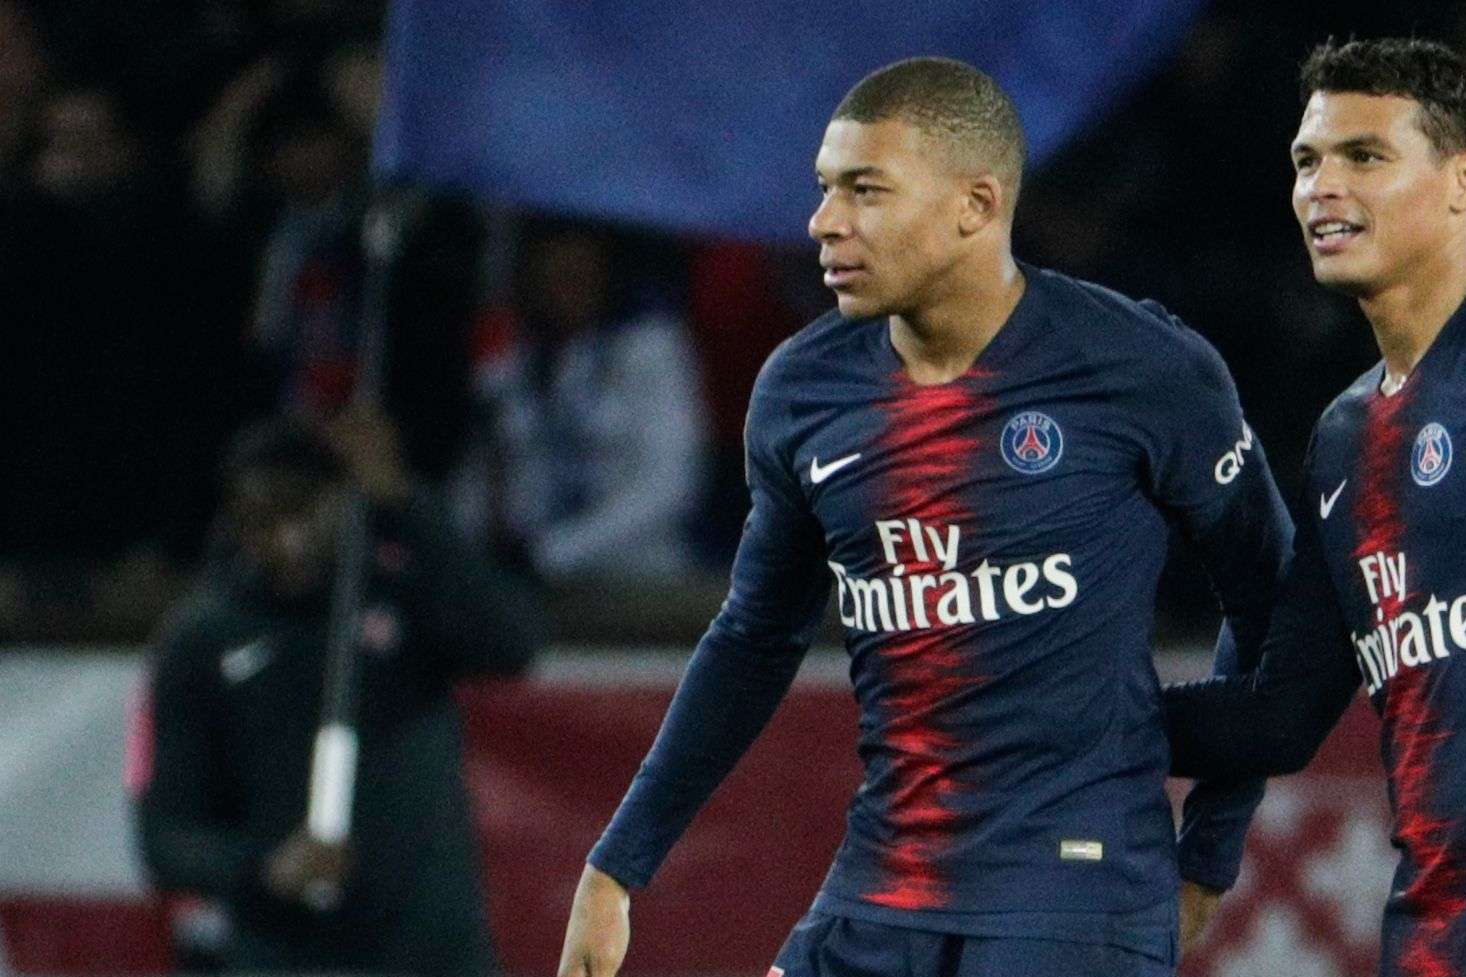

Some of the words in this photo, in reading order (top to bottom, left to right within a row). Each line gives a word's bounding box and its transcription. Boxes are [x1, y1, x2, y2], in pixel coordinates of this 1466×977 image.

[1214, 418, 1252, 485] QN
[875, 517, 960, 571] Fly
[827, 552, 1078, 632] Emirates
[1358, 550, 1407, 605] Fly
